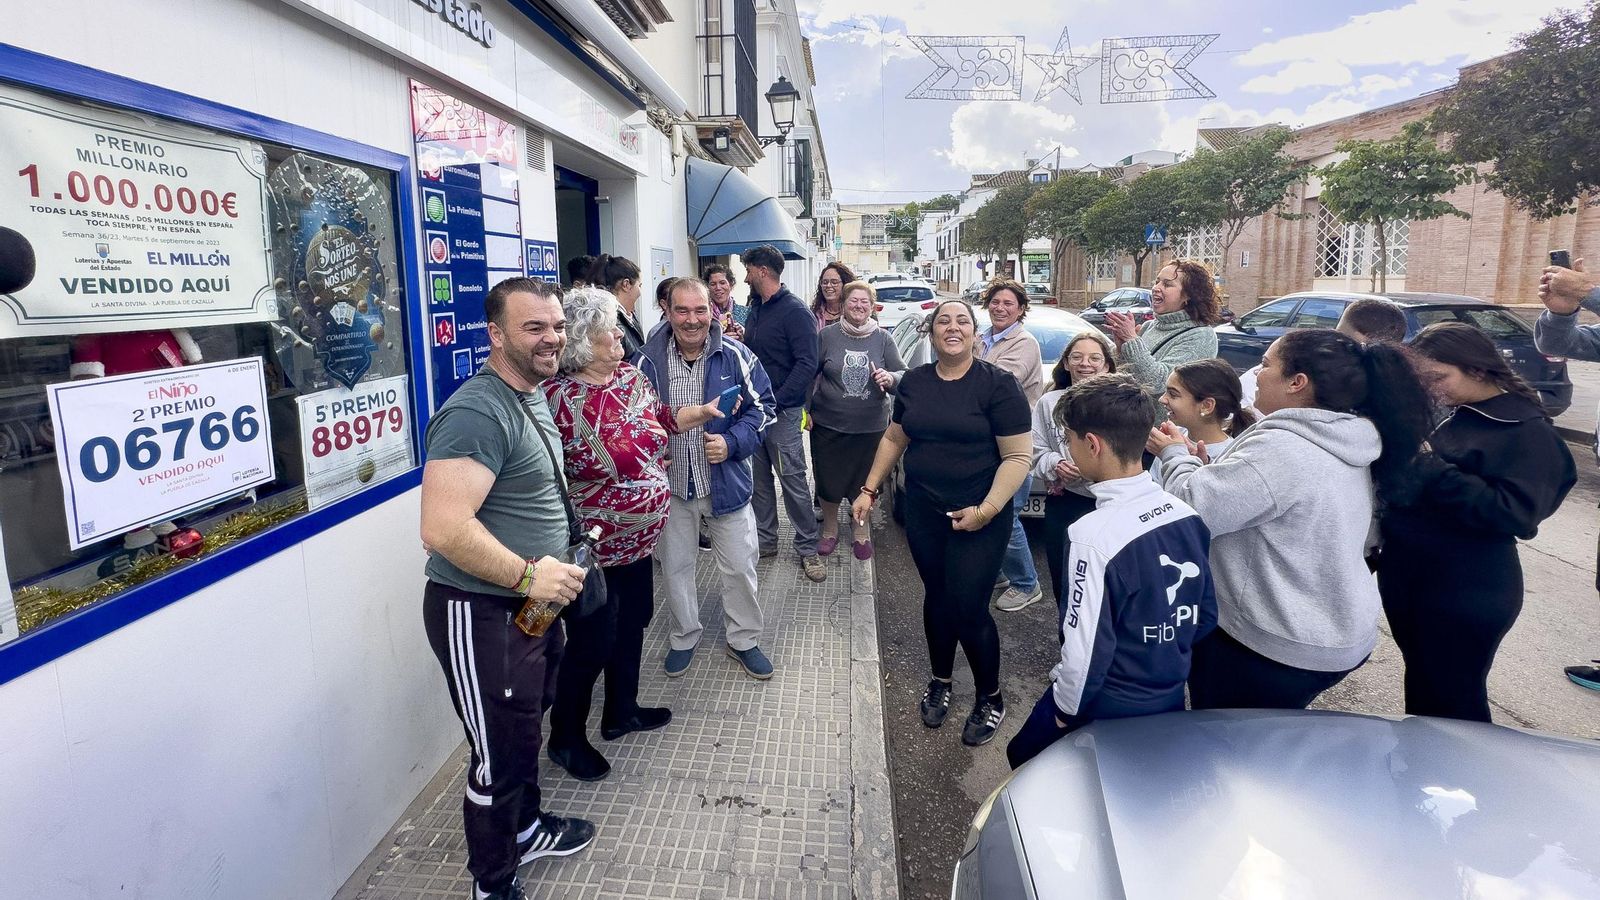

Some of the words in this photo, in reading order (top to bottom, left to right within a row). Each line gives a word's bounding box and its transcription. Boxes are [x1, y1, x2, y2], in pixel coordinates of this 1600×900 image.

[412, 0, 496, 48] stado
[94, 133, 165, 158] PREMIO
[75, 147, 188, 178] MILLONARIO
[444, 165, 480, 180] Euromillones
[18, 163, 239, 219] 1.000.000€
[30, 205, 67, 215] TODAS
[69, 209, 88, 217] LAS
[137, 215, 152, 223] DOS
[154, 217, 194, 226] MILLONES
[208, 221, 234, 229] ESPAÑA
[447, 204, 456, 213] La
[456, 206, 481, 217] Primitiva
[62, 230, 95, 239] Semana
[86, 219, 110, 227] TOCA
[112, 222, 149, 231] SIEMPRE,
[170, 226, 201, 234] ESPAÑA
[335, 236, 345, 249] EL
[455, 239, 462, 247] El
[462, 240, 479, 248] Gordo
[147, 251, 167, 265] EL
[318, 240, 356, 268] SORTEO
[460, 252, 484, 260] Primitiva
[59, 277, 173, 294] VENDIDO
[181, 275, 230, 293] AQUÍ
[324, 272, 340, 290] NOS
[340, 263, 357, 282] UNE
[458, 284, 483, 293] Bonoloto
[458, 323, 466, 331] La
[466, 320, 488, 331] Quiniela
[240, 364, 257, 372] ENERO
[159, 382, 198, 400] Niño
[150, 395, 216, 419] PREMIO
[331, 389, 397, 419] PREMIO
[312, 406, 404, 458] 88979
[79, 404, 260, 483] 06766
[138, 463, 194, 487] VENDIDO
[242, 470, 264, 479] NACIONAL
[1022, 498, 1047, 513] 98
[1138, 502, 1174, 523] GIVOVA
[1067, 558, 1088, 629] GIVOVA
